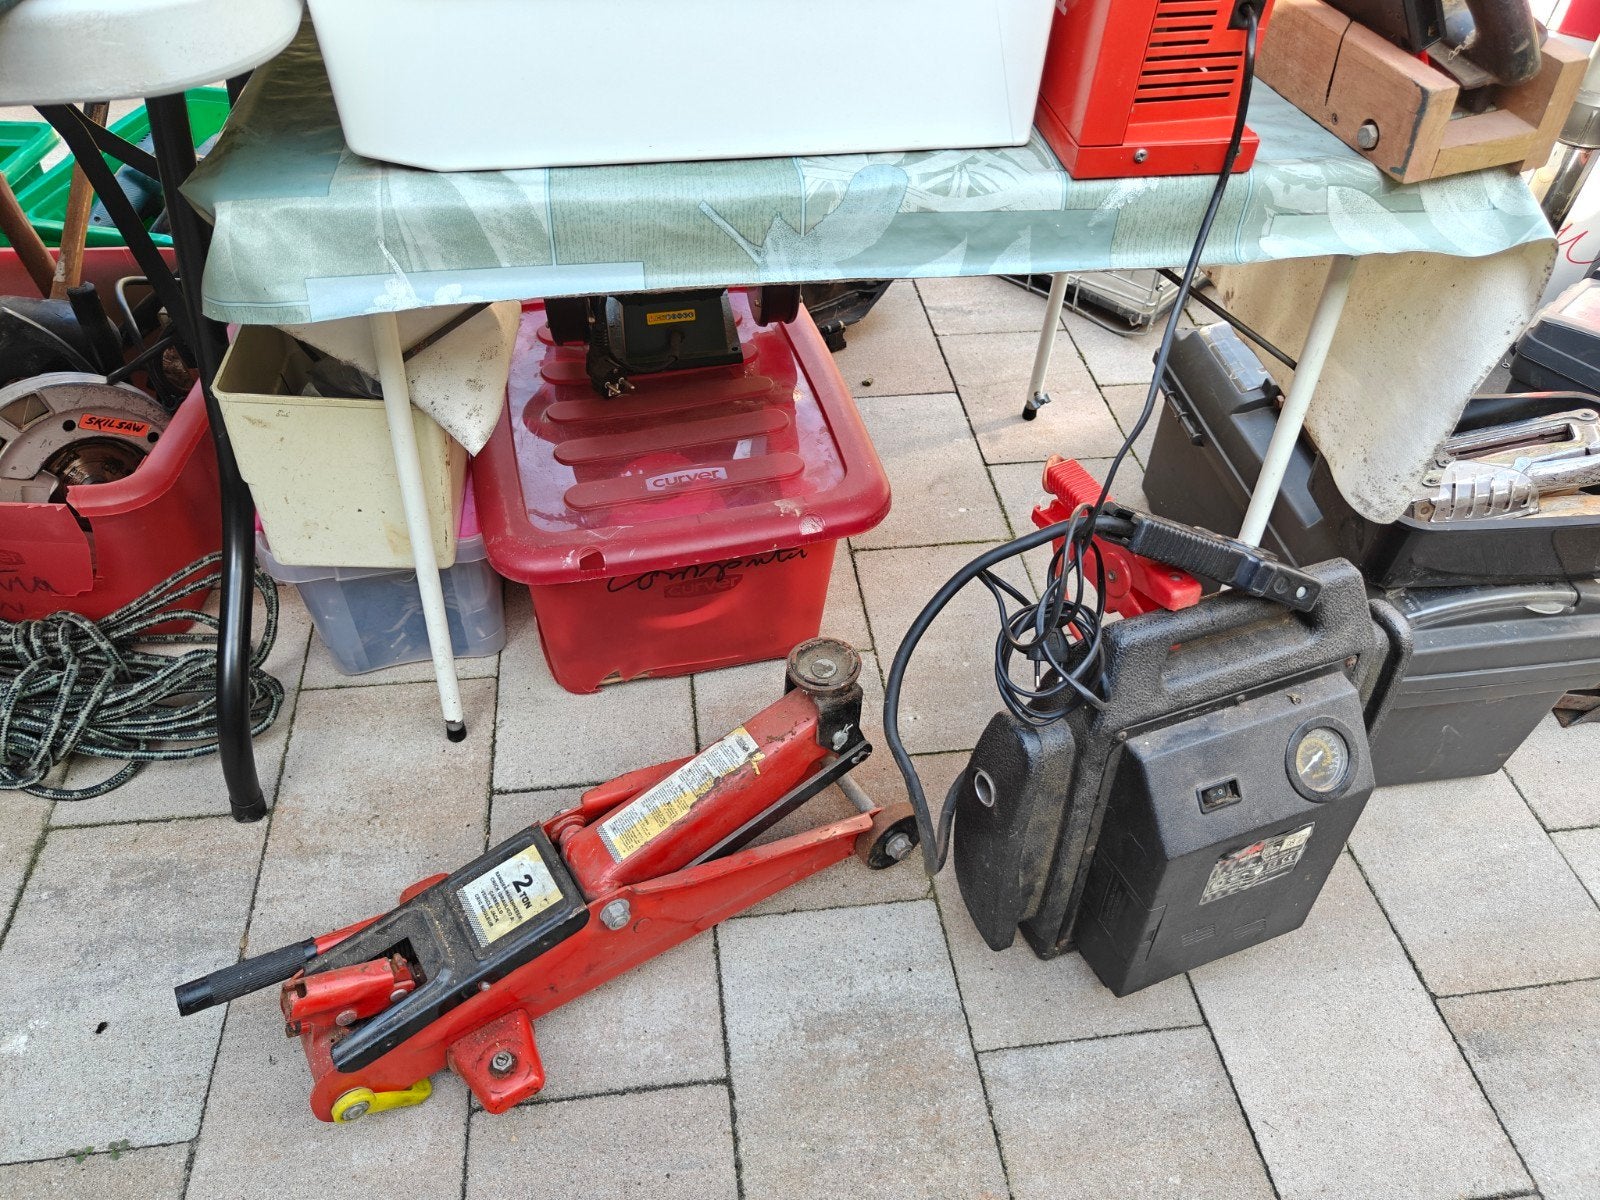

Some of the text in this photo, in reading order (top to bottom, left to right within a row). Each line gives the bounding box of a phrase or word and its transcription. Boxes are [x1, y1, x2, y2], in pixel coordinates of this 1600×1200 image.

[652, 469, 720, 488] curver
[512, 874, 533, 909] 2 TON
